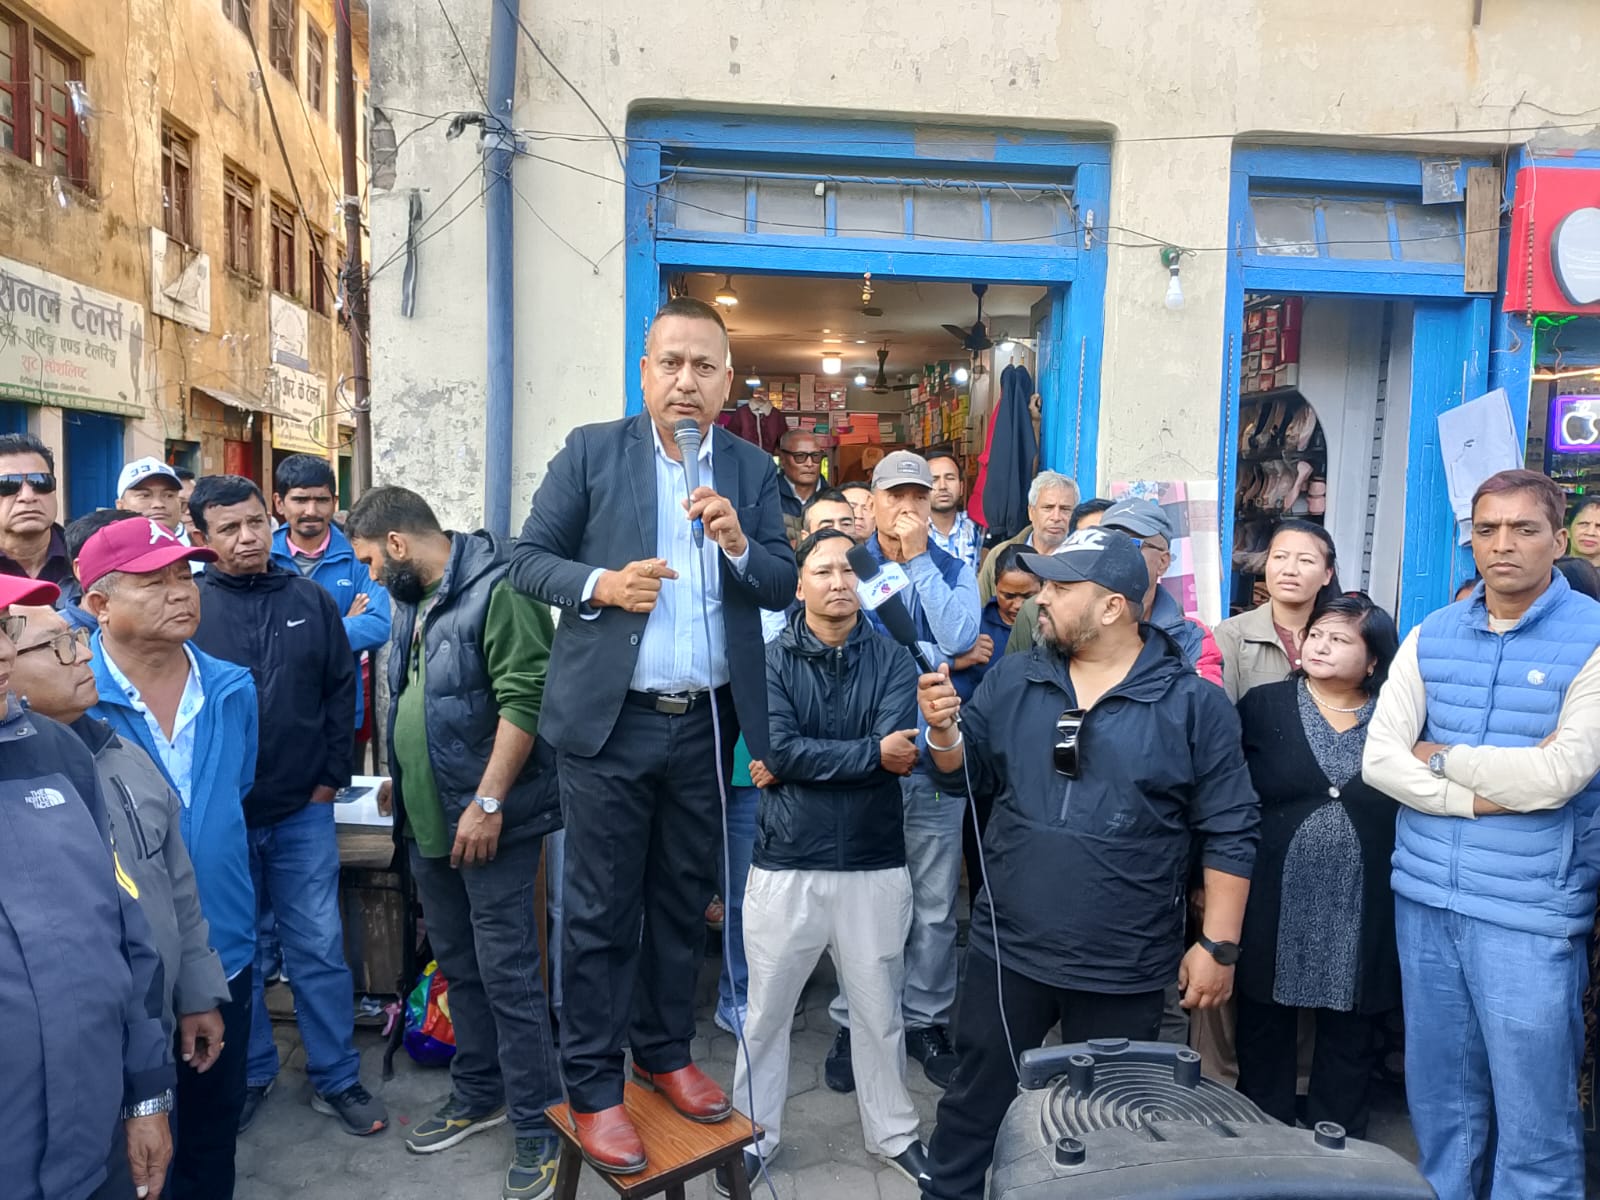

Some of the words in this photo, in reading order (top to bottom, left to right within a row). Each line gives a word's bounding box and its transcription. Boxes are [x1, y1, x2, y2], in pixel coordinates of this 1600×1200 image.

[71, 286, 123, 341] टेलर्स
[30, 788, 45, 796] THE
[25, 794, 48, 803] NORTH
[34, 801, 51, 809] FACE
